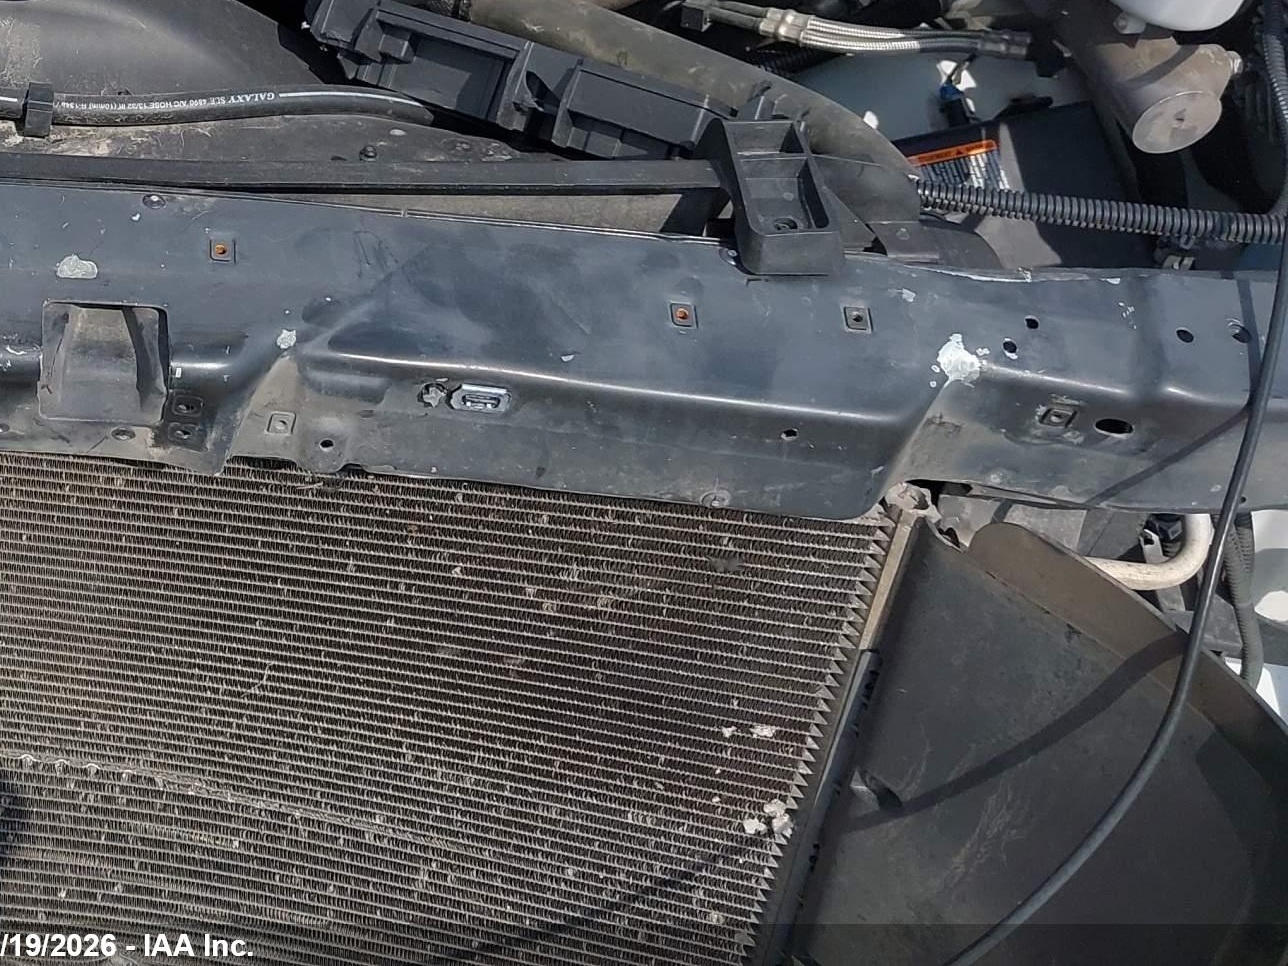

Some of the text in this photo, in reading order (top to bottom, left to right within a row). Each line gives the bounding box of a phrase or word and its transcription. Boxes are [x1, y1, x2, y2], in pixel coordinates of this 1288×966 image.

[210, 96, 227, 106] SLE
[229, 92, 275, 104] GALAXY
[88, 102, 117, 111] (10mm)
[149, 101, 172, 110] HOSE
[173, 100, 187, 108] A/C
